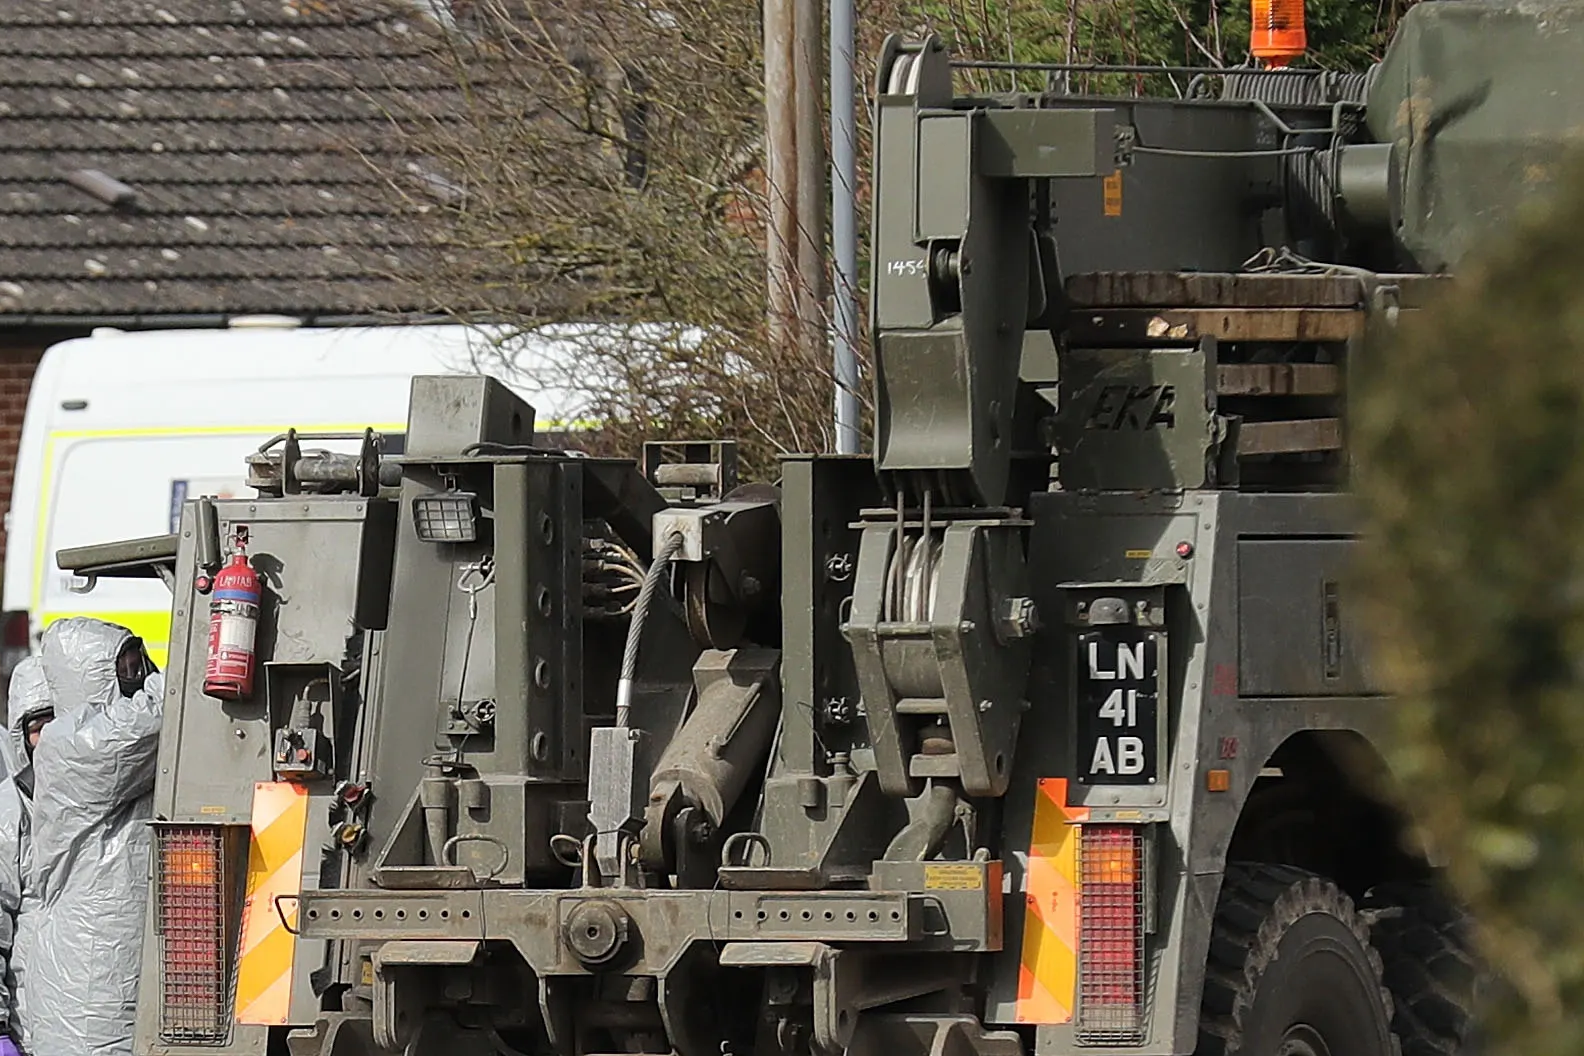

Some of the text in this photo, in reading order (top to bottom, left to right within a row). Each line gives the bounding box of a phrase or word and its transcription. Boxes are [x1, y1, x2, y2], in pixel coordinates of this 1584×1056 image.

[1084, 384, 1176, 431] EKA
[1088, 641, 1145, 680] LN
[1098, 688, 1137, 727] 41
[1089, 736, 1145, 775] AB
